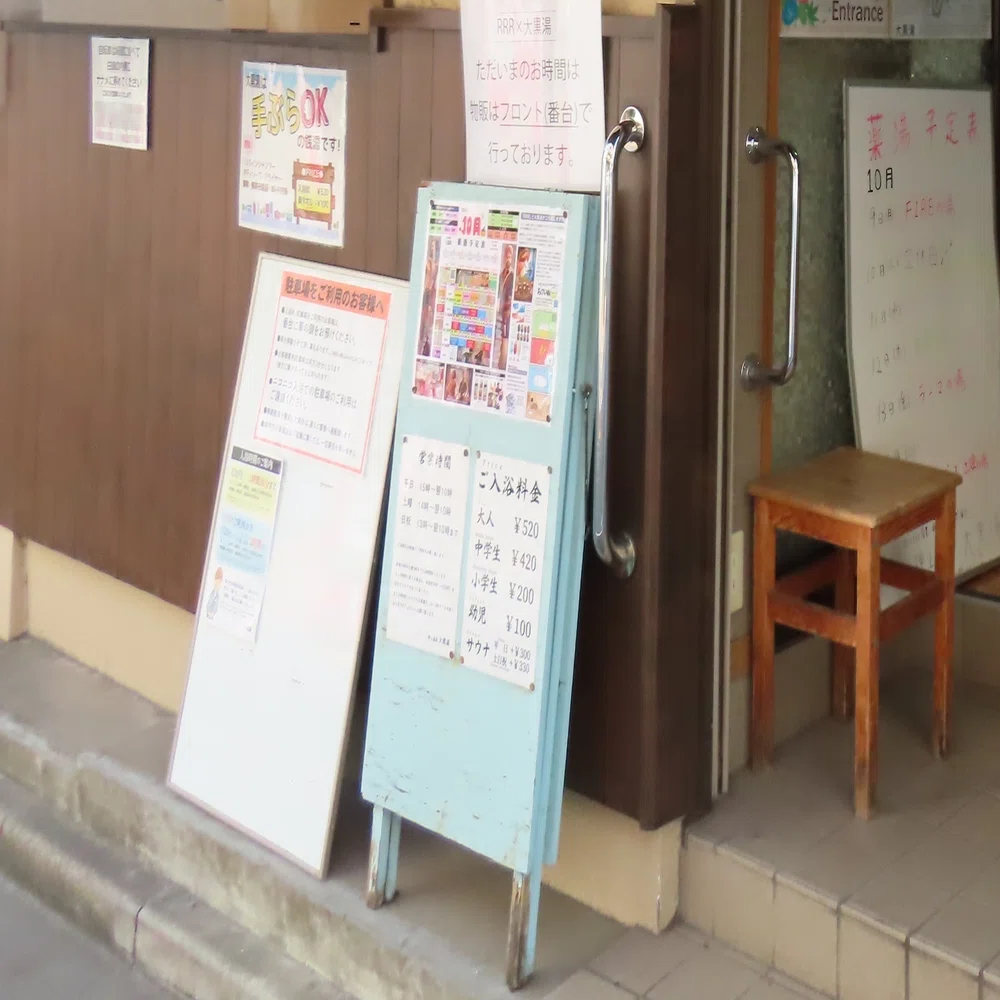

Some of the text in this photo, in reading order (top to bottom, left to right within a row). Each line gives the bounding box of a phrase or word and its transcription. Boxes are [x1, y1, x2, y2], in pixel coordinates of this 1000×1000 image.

[831, 0, 884, 22] Entrance
[476, 58, 580, 81] ただいまのお時間は
[488, 142, 575, 167] 行っております。
[866, 166, 894, 193] 10月
[285, 276, 384, 313] 駐車場をご利用のお客様へ
[479, 471, 542, 504] ご入浴料金
[476, 507, 539, 539] 大人 ¥520
[474, 539, 501, 562] 中学生
[511, 548, 537, 572] ¥420
[471, 572, 498, 595] 小学生
[509, 581, 535, 605] ¥200
[468, 604, 532, 638] 幼児 ¥100
[466, 637, 490, 658] サウナ
